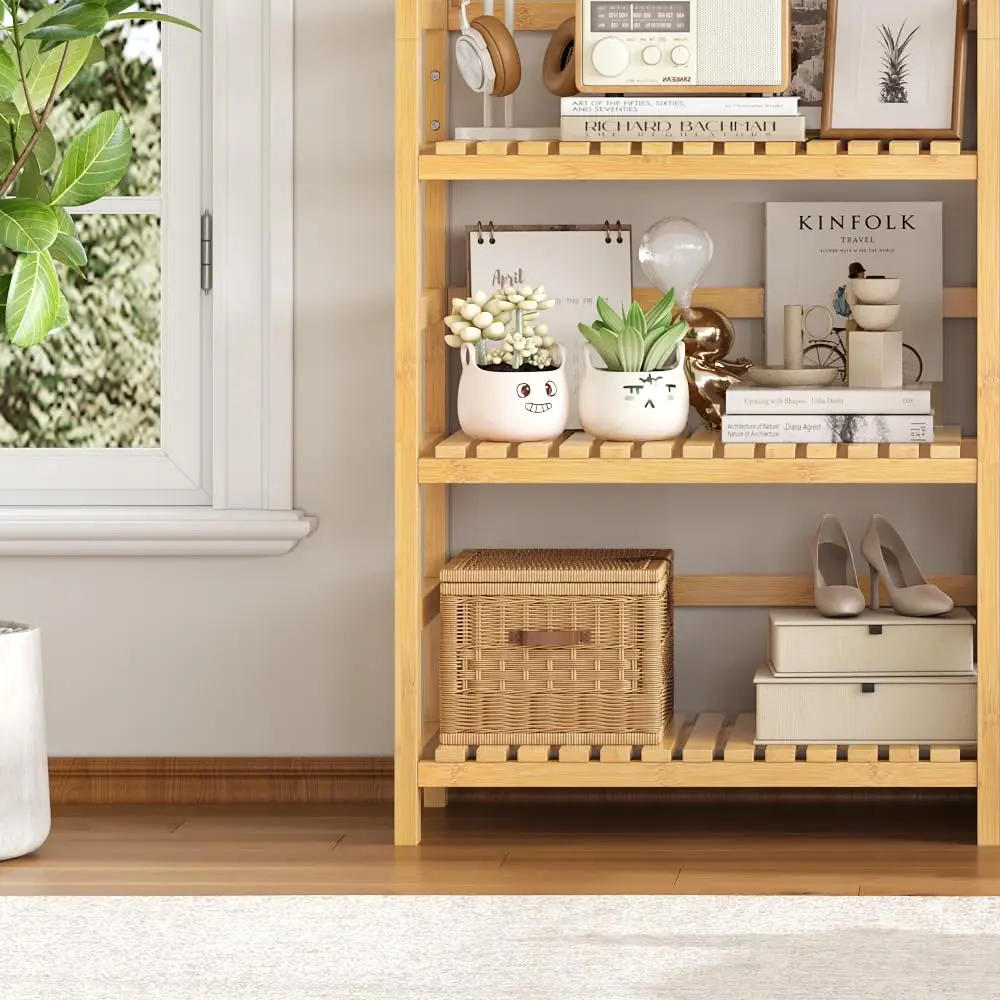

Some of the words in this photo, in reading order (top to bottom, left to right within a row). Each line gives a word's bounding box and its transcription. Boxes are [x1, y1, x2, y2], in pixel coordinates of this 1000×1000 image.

[584, 121, 672, 132] RICHARD
[799, 214, 917, 230] KINFOLK
[492, 267, 525, 287] April
[785, 423, 800, 431] Diana
[801, 423, 822, 432] Agrest
